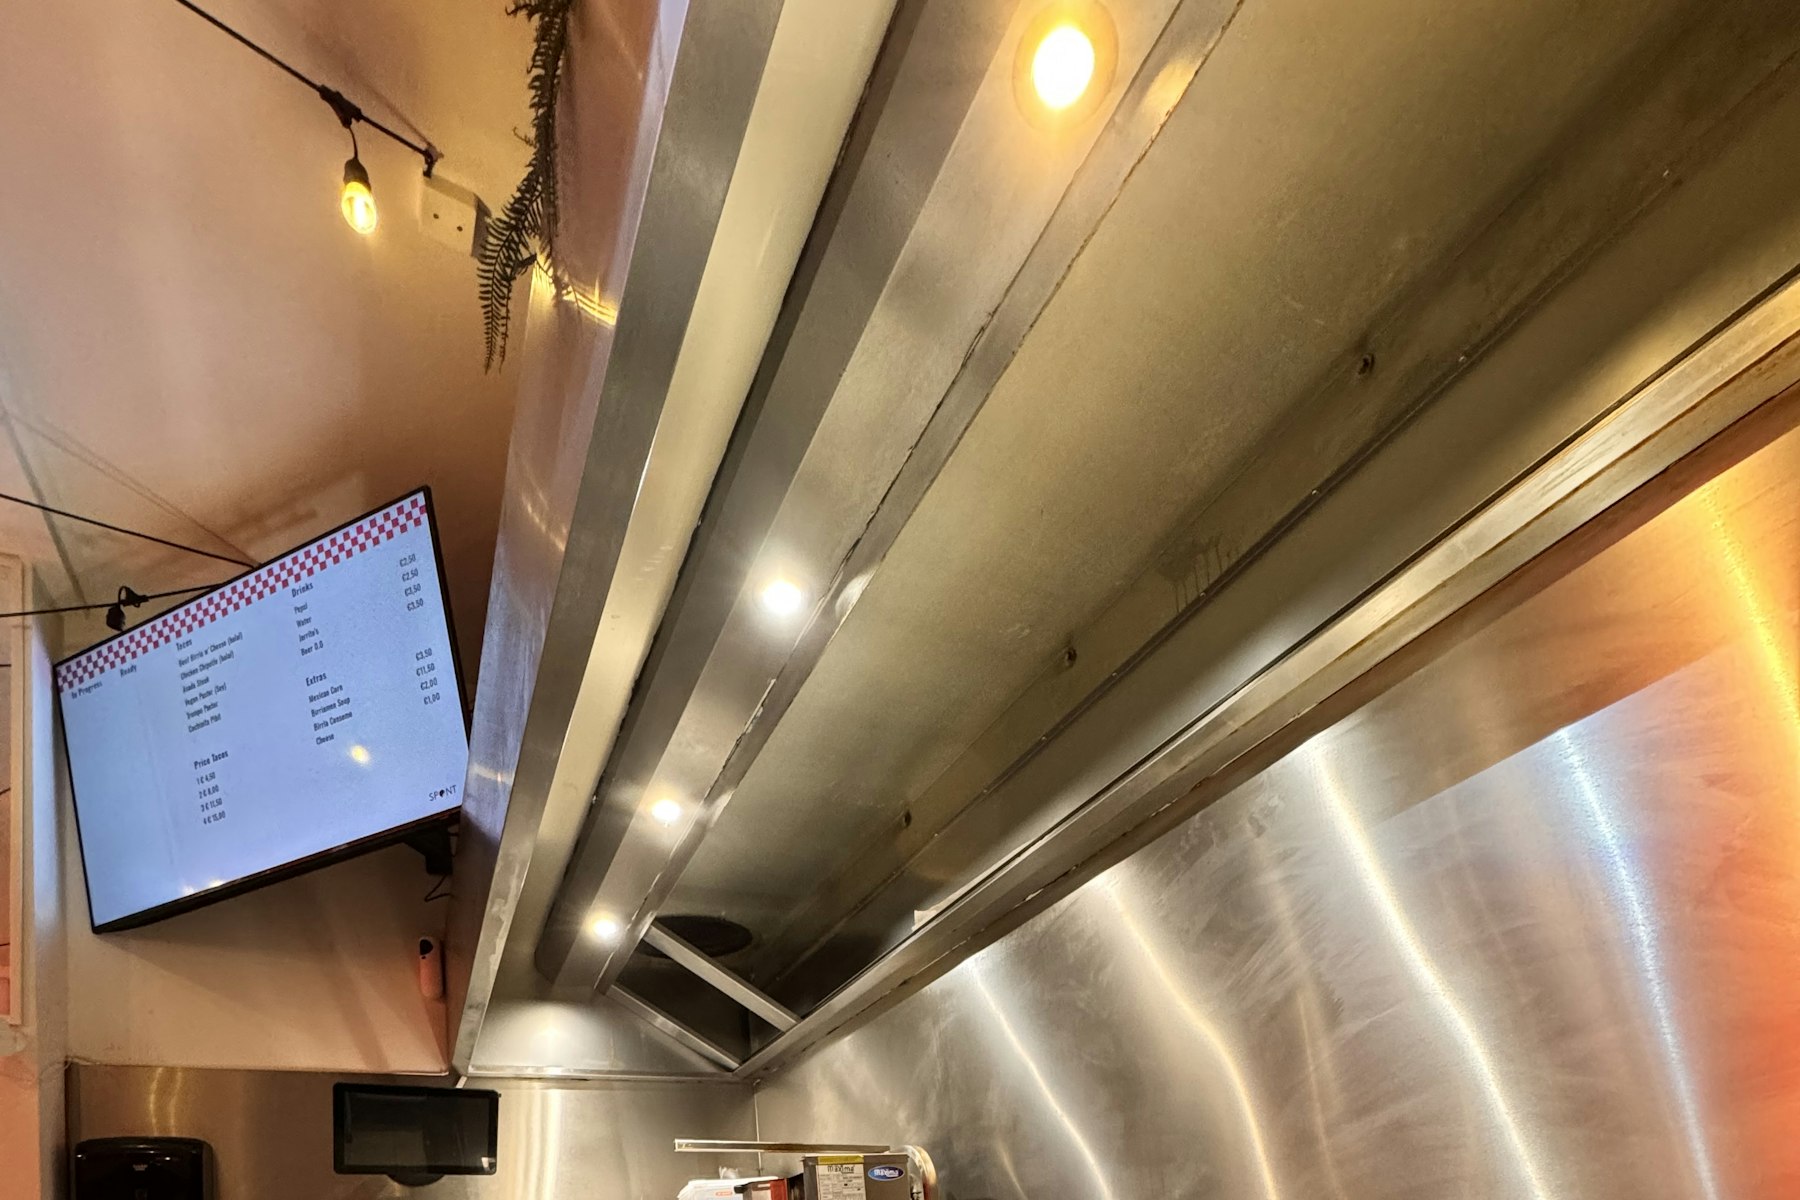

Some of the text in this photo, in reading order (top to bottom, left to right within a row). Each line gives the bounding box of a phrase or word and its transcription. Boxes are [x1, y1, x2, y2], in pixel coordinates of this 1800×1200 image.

[291, 583, 314, 598] Drinks
[296, 617, 312, 628] Water
[176, 639, 192, 651] Tacos
[210, 641, 226, 652] Cheese
[301, 646, 313, 656] Beer
[120, 665, 136, 678] Ready
[180, 668, 198, 680] Chicken
[309, 648, 432, 703] Mexican Corn €3,50
[306, 673, 327, 687] Extras
[337, 697, 350, 707] Soup
[416, 663, 435, 676] €11,50
[78, 681, 103, 696] Progress
[313, 720, 329, 731] Birria
[420, 677, 438, 691] €2,00
[316, 693, 440, 745] Cheese €1,00
[194, 750, 228, 770] Price Tacos
